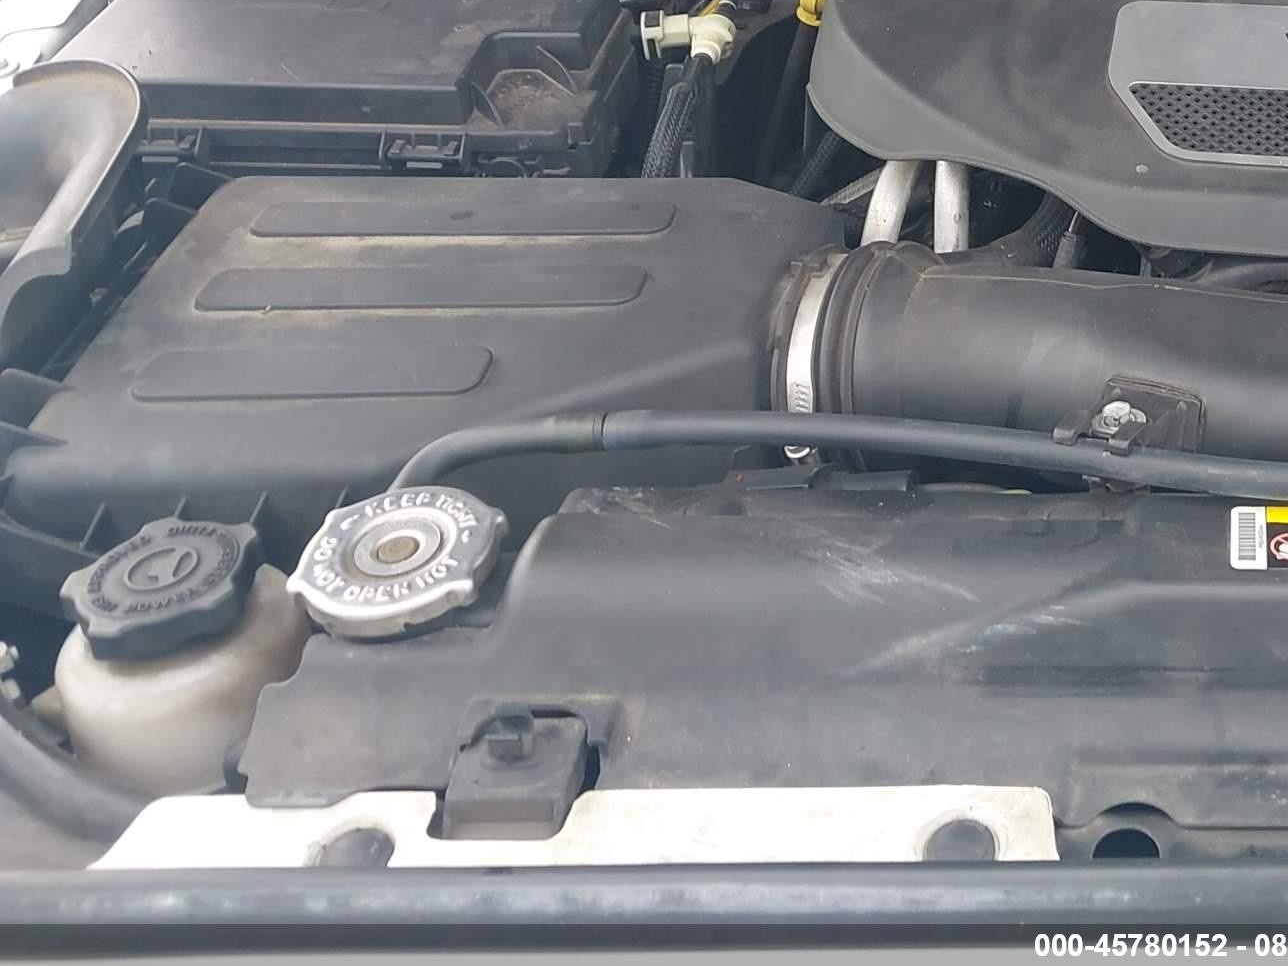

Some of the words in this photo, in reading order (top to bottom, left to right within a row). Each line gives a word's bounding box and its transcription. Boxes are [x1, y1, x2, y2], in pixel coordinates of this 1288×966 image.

[364, 491, 432, 517] KEEP
[342, 580, 411, 603] OPEN
[415, 555, 459, 589] HOT
